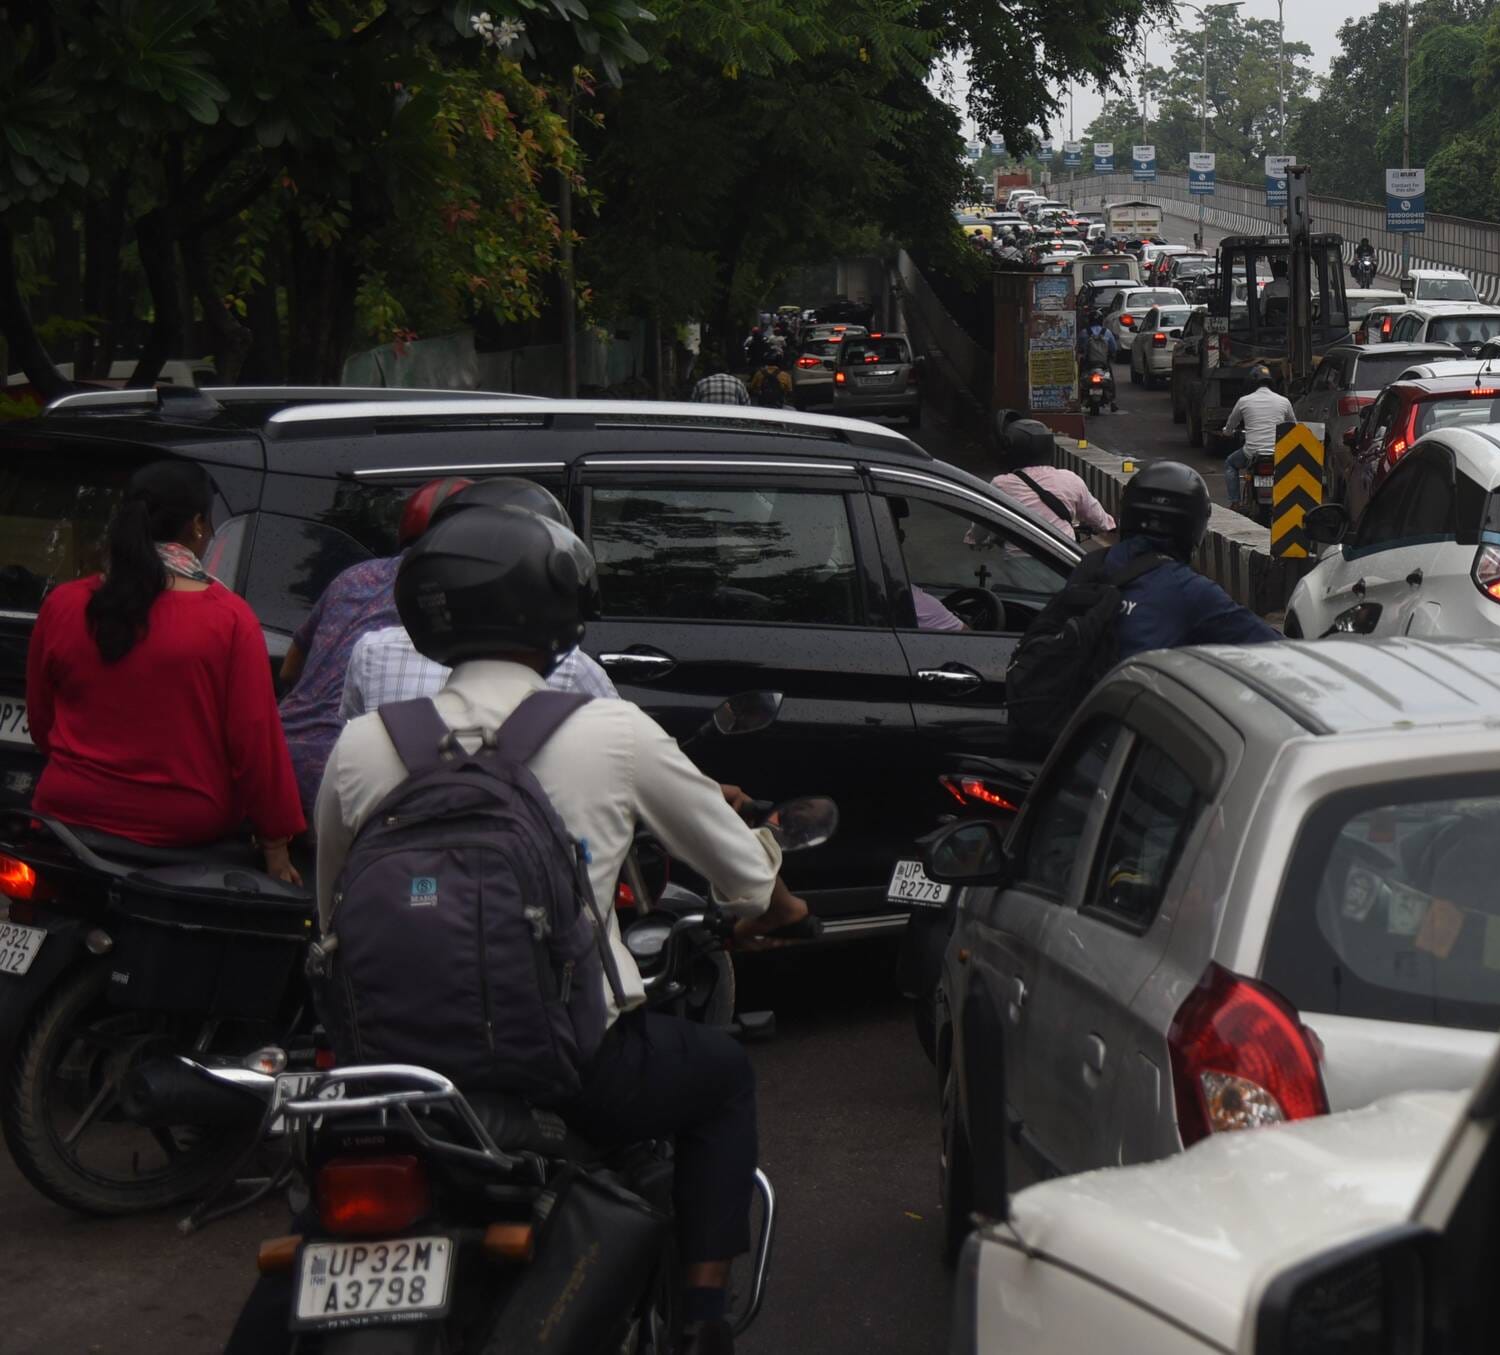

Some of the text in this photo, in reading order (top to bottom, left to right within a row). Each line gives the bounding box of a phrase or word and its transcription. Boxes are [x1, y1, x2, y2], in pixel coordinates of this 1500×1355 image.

[0, 703, 29, 733] P7
[899, 880, 942, 899] R2778
[329, 1242, 431, 1276] UP32M
[323, 1275, 426, 1313] A3798
